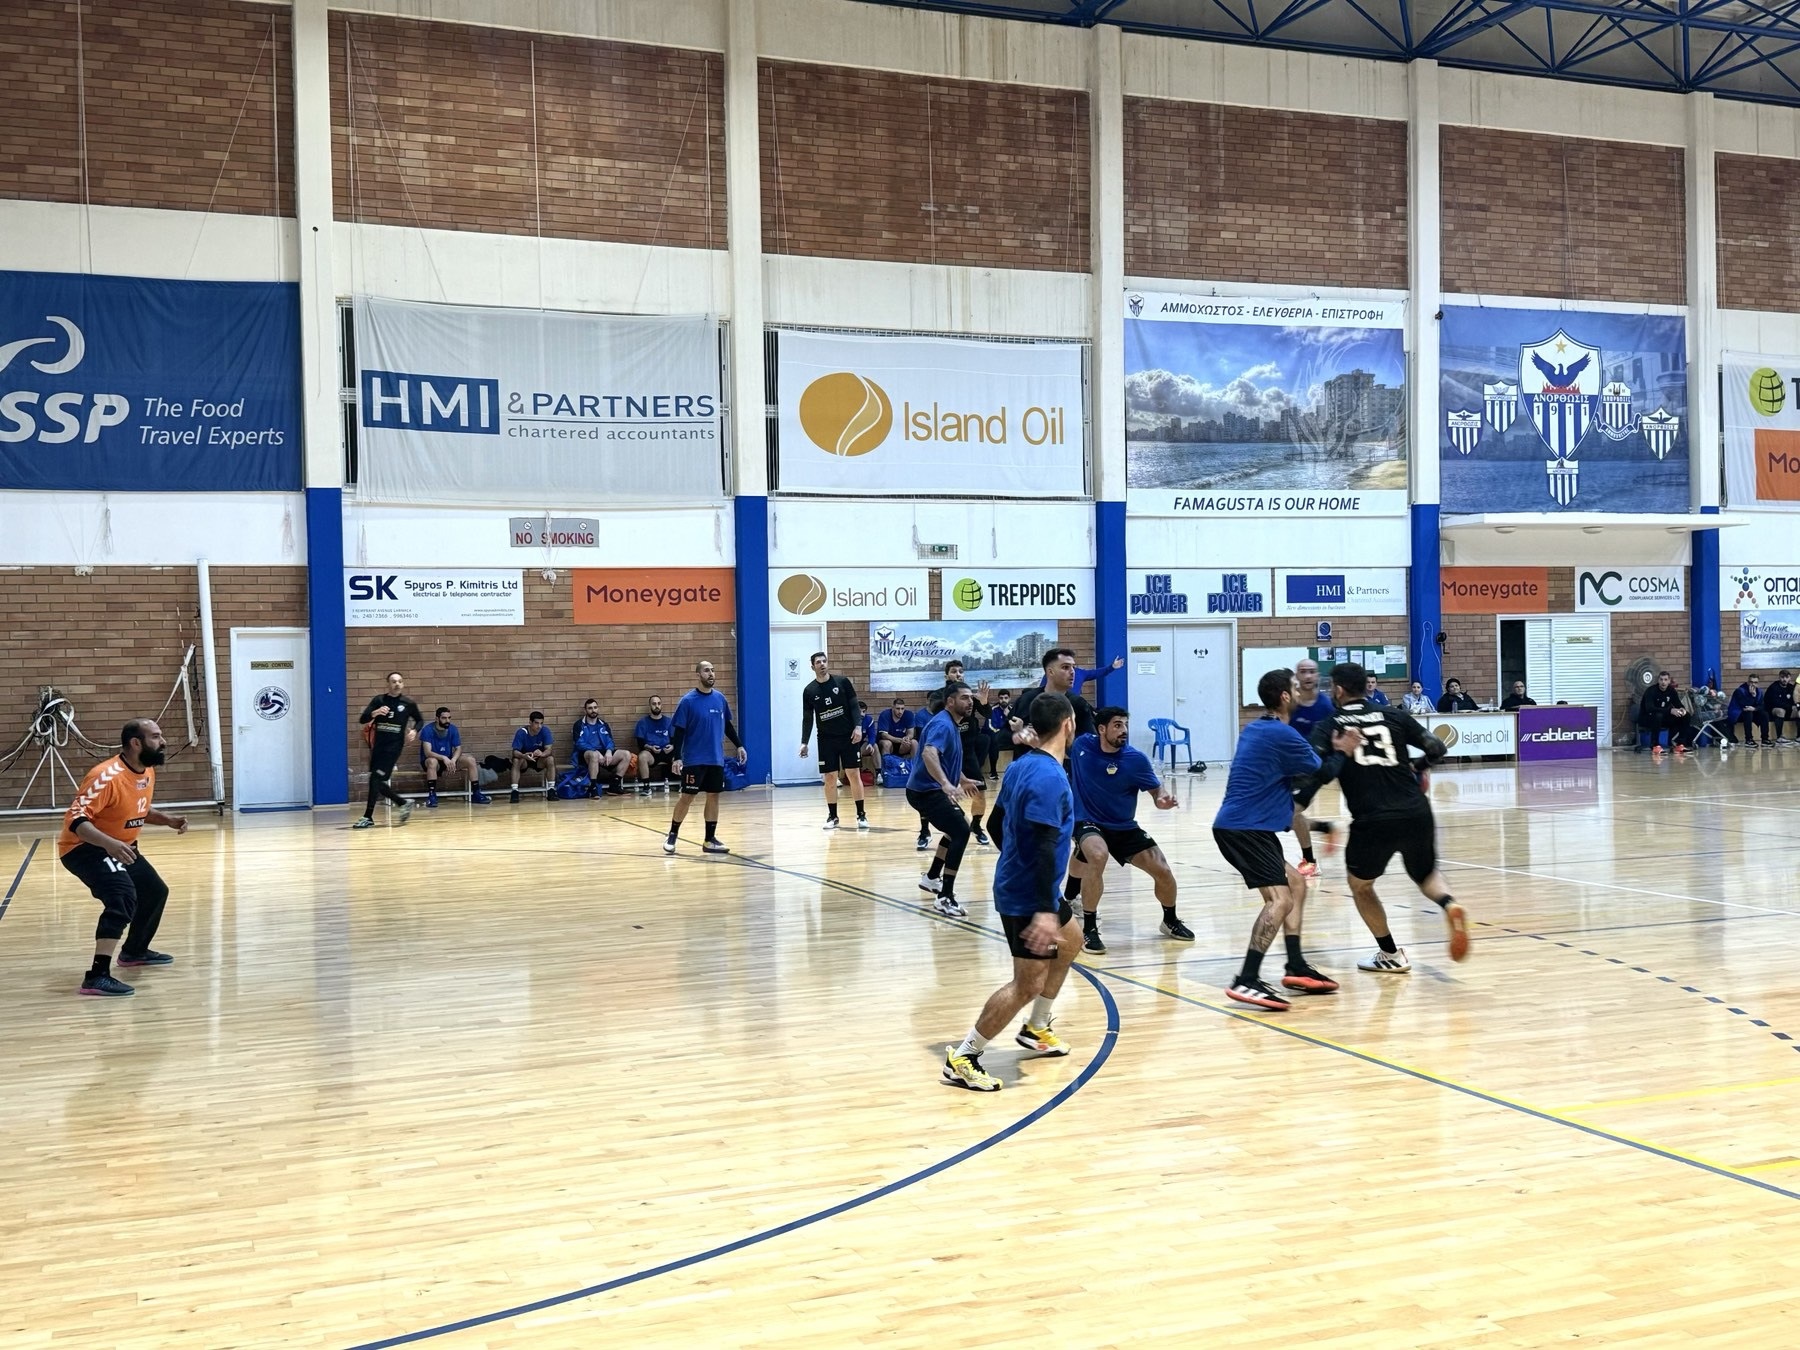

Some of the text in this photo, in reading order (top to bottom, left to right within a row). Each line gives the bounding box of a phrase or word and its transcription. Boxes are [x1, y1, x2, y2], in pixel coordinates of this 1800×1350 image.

[1160, 302, 1244, 316] ΑΜΜΟΧΩΣΤΟΣ
[1252, 306, 1313, 318] ΕΛΕΥΘΕΡΙΑ
[1321, 308, 1384, 320] ΕΠΙΣΤΡΟΦΗ
[144, 398, 244, 418] The Food
[371, 377, 715, 428] HMI & PARTNERS
[1551, 405, 1558, 415] 9
[0, 391, 130, 444] SSP
[904, 401, 1064, 446] Island Oil
[139, 426, 285, 450] Travel Experts
[508, 425, 715, 441] chartered accountants
[1768, 452, 1800, 474] Mo
[1173, 497, 1360, 511] FAMAGUSTA IS OUR HOME
[515, 532, 594, 545] NO SMOKING
[349, 575, 398, 601] SK
[404, 580, 442, 592] Spyros
[460, 580, 498, 590] Kimitris
[502, 580, 518, 590] Ltd
[1145, 574, 1172, 593] ICE
[1222, 574, 1248, 592] ICE
[1316, 585, 1390, 596] HMI & Partners
[1441, 581, 1538, 600] Moneygate
[1629, 577, 1680, 593] COSMA
[449, 591, 479, 599] telephone
[586, 584, 721, 607] Moneygate
[832, 586, 917, 607] Island Oil
[988, 583, 1076, 606] TREPPIDES
[1130, 593, 1188, 614] POWER
[1207, 592, 1263, 613] POWER
[824, 697, 832, 706] 21
[1461, 729, 1509, 744] Island Oil
[1532, 727, 1595, 742] cablenet
[685, 774, 696, 784] 15
[137, 797, 147, 813] 12
